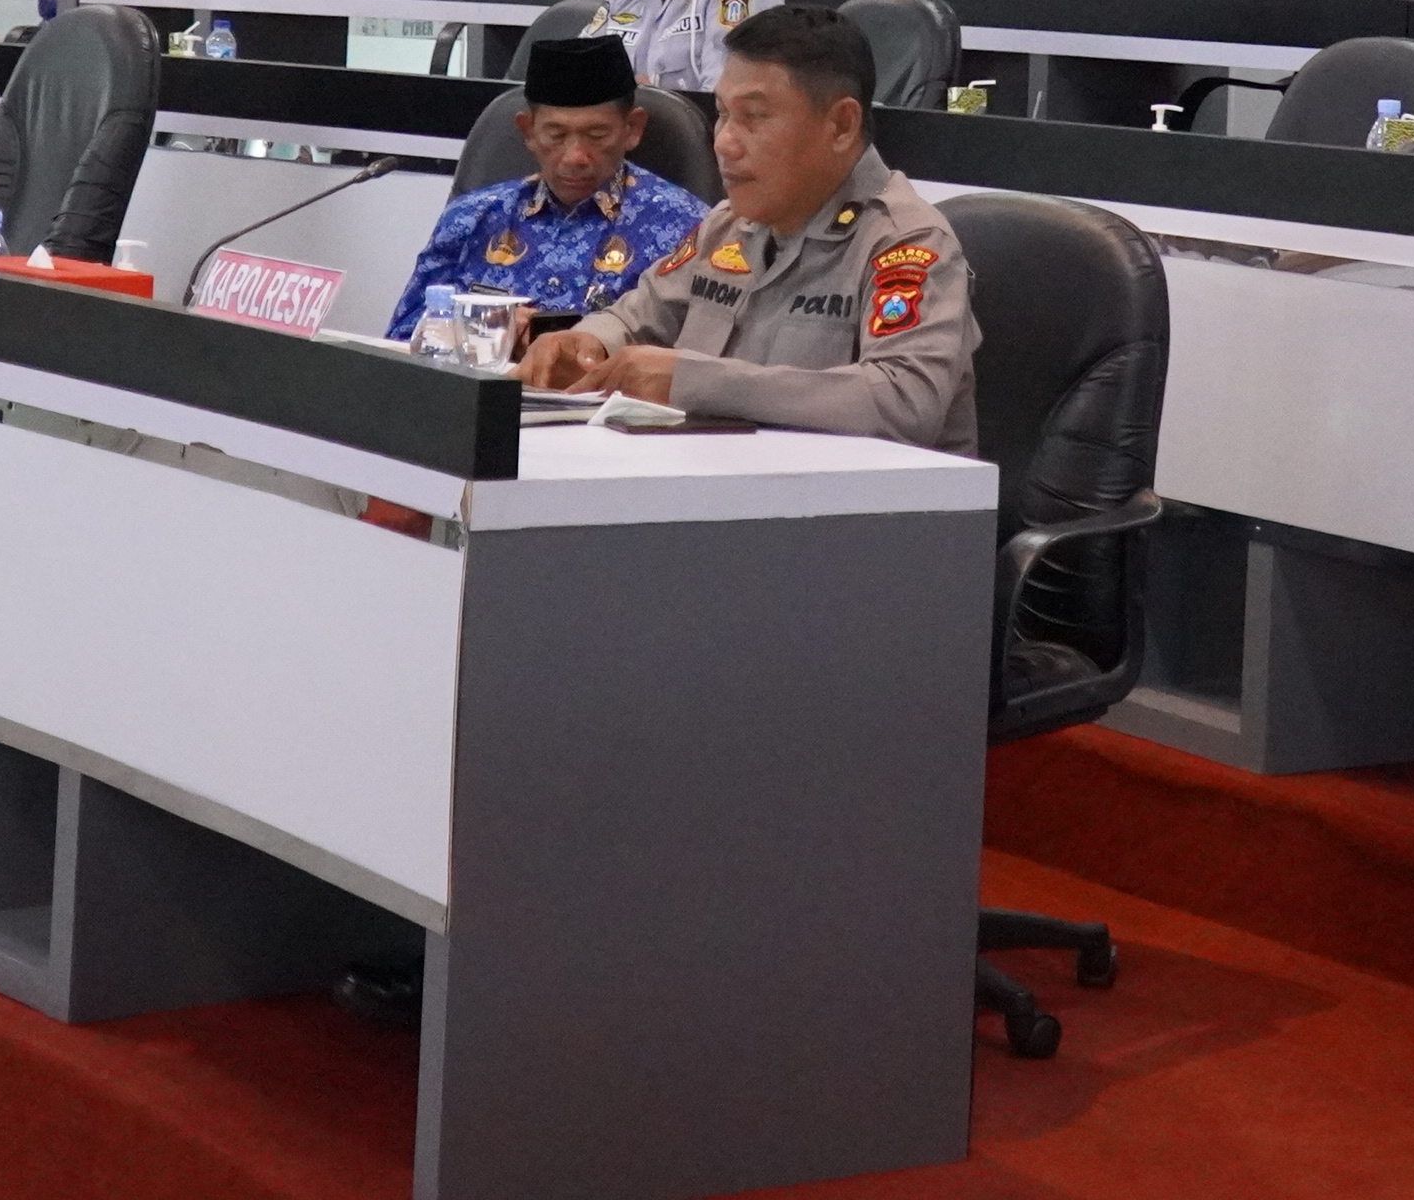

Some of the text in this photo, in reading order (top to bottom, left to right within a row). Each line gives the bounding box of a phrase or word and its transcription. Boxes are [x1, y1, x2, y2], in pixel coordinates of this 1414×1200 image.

[878, 248, 932, 264] POLRES
[198, 259, 334, 329] KAPOLRESTA
[789, 294, 853, 318] POLRI
